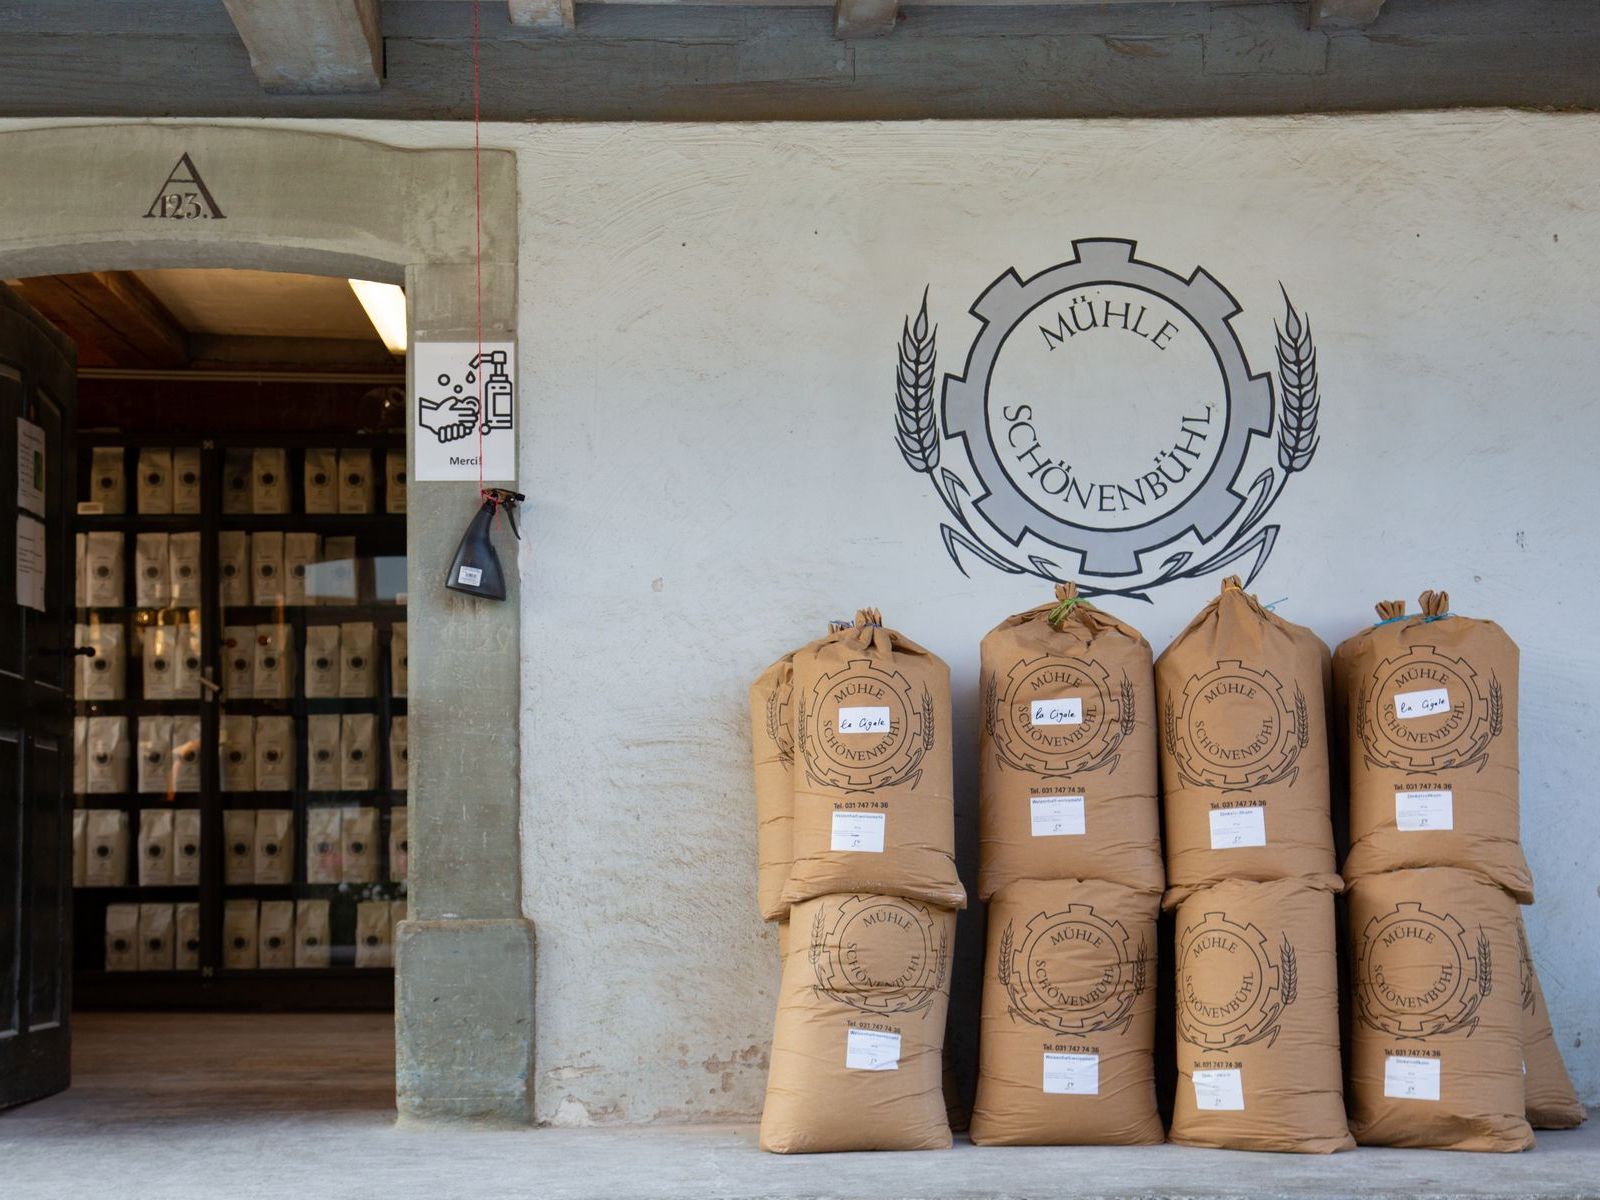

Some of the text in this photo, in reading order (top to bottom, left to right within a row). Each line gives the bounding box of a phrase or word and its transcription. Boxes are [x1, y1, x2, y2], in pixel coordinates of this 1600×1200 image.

[1038, 295, 1179, 351] MÜHLE
[1003, 404, 1212, 512] SCHÖNENBÜHL
[1030, 671, 1082, 691] MÜHLE
[1395, 667, 1449, 688] MÜHLE
[834, 682, 885, 704] MÜHLE
[1204, 682, 1257, 704] MÜHLE
[1384, 701, 1465, 743] SCHÖNENBÜHL
[823, 717, 900, 761] SCHÖNENBÜHL
[1195, 716, 1273, 760] SCHÖNENBÜHL
[863, 909, 912, 933] MÜHLE
[1050, 926, 1104, 949] MÜHLE
[1192, 936, 1238, 959] MÜHLE
[1382, 925, 1436, 948] MÜHLE
[1035, 961, 1114, 1006] SCHÖNENBÜHL
